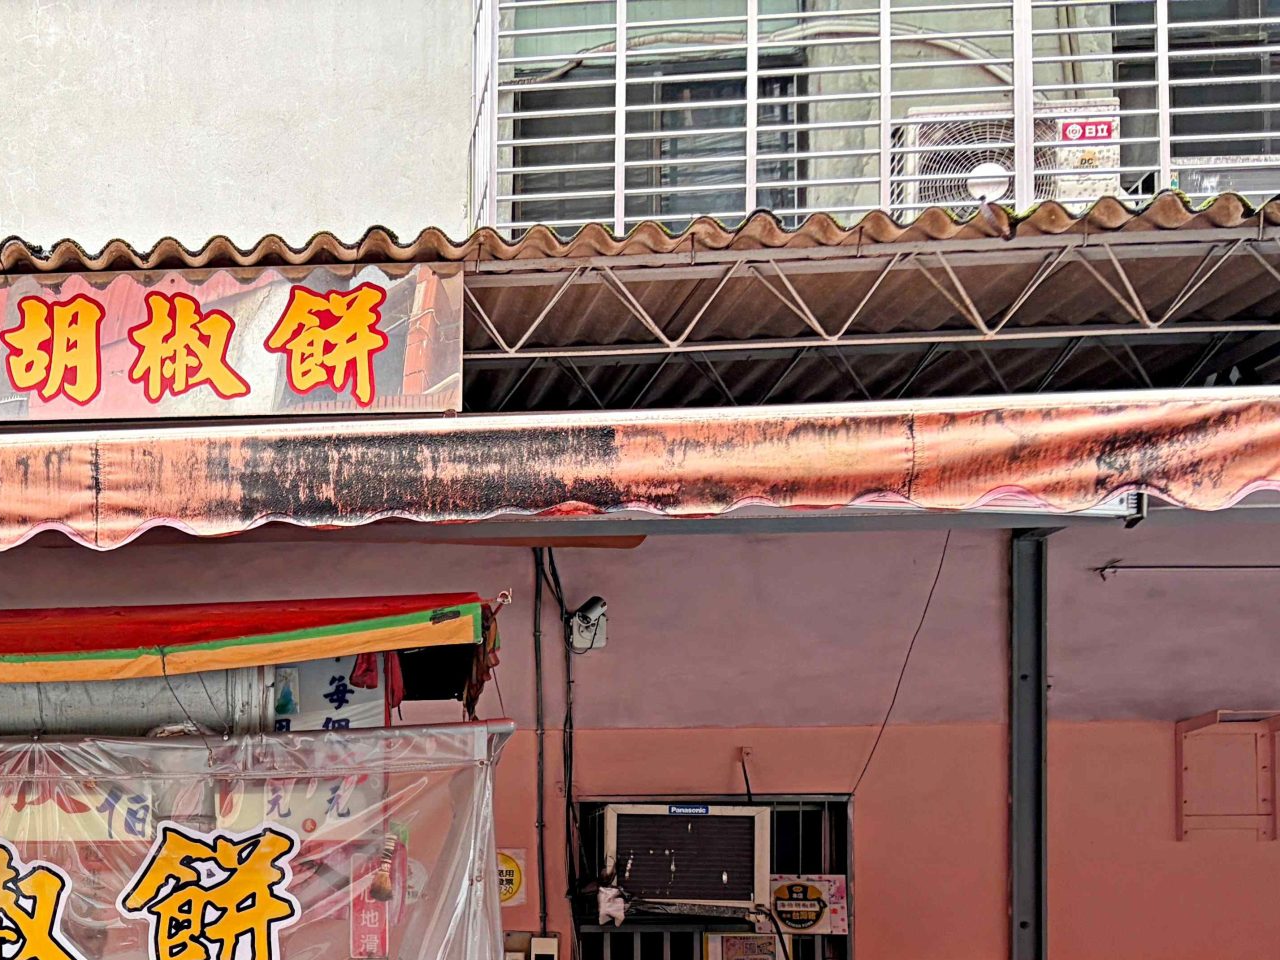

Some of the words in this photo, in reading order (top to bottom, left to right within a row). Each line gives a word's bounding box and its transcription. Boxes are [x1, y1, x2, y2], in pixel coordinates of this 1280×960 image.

[1084, 124, 1109, 137] 日立
[1080, 157, 1094, 166] DC
[671, 806, 707, 815] Panasonic
